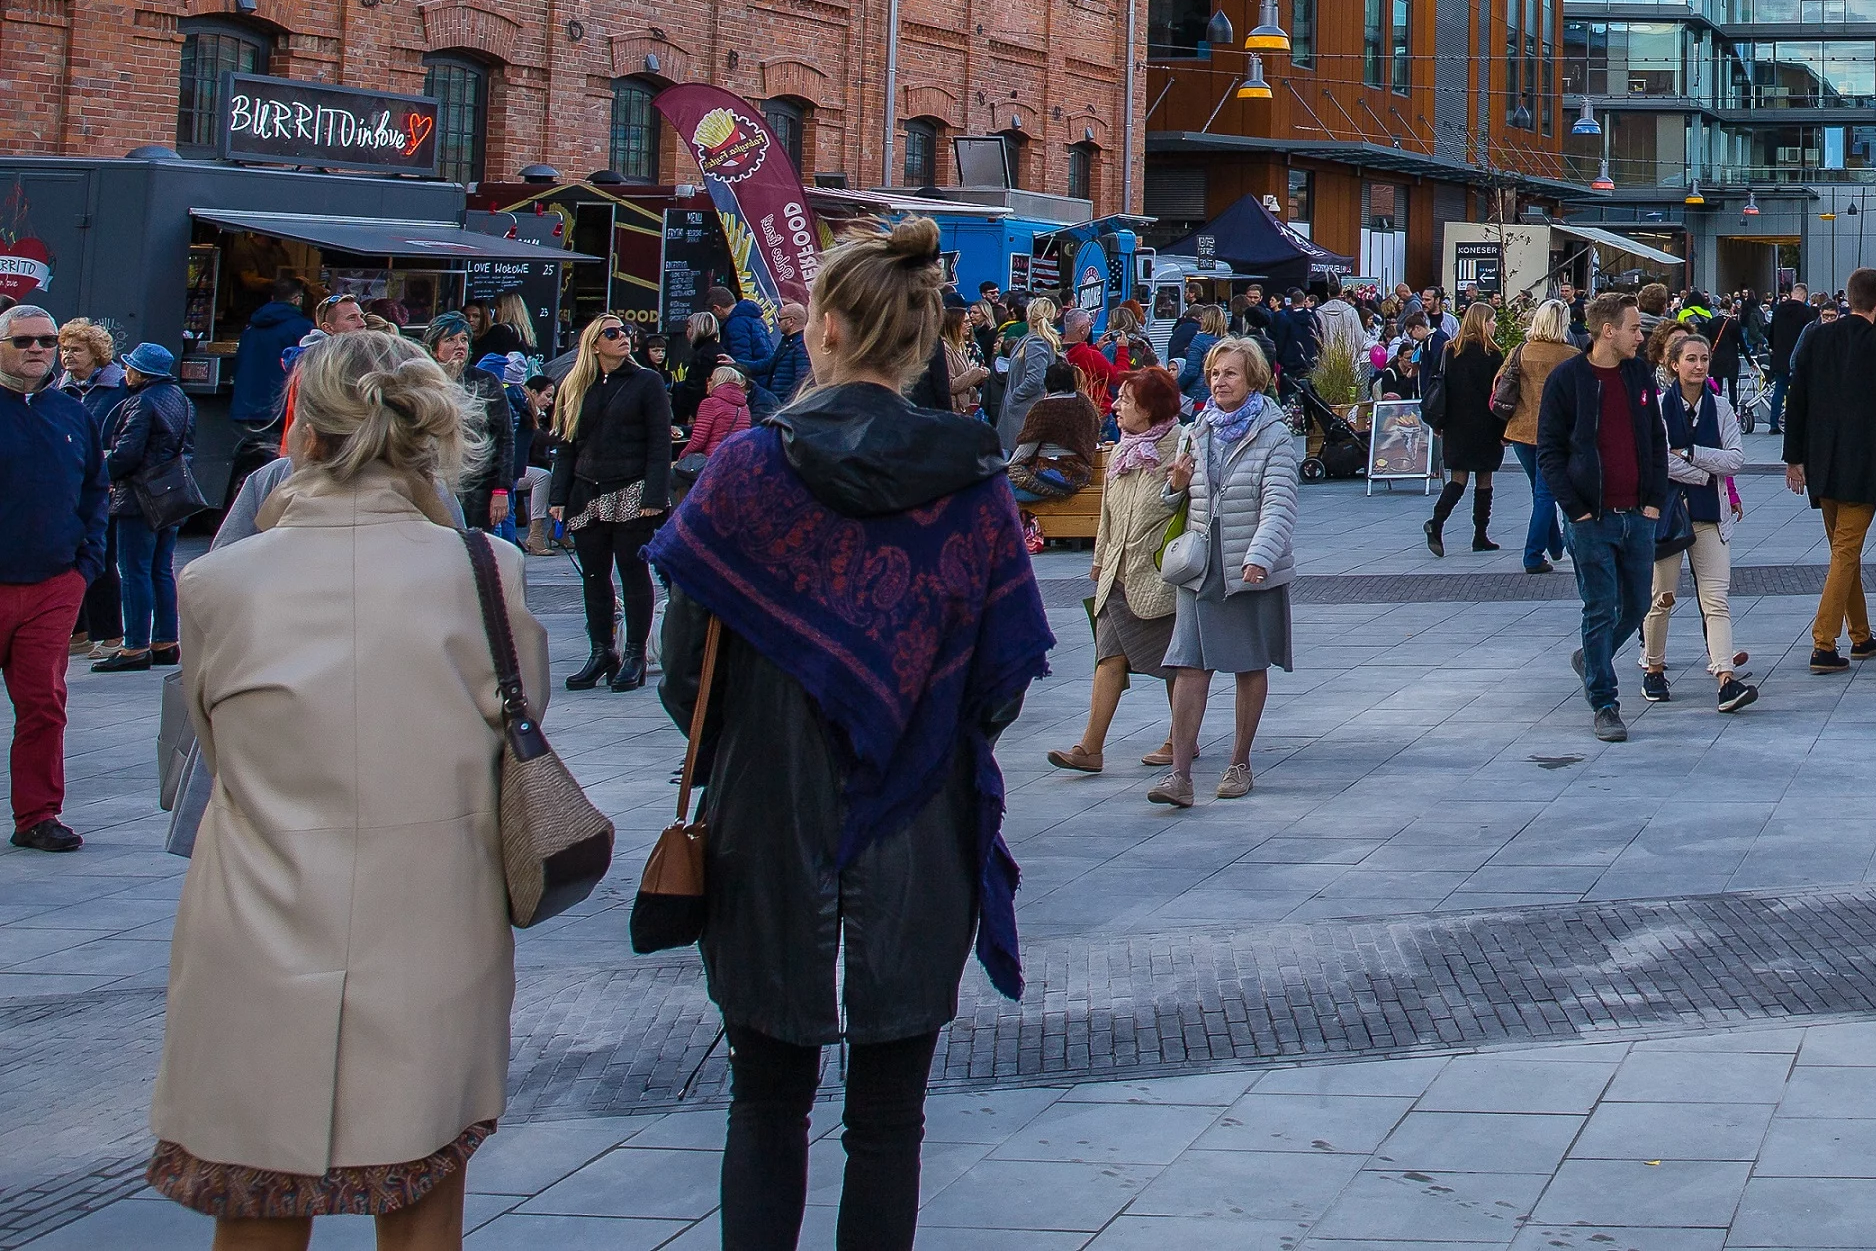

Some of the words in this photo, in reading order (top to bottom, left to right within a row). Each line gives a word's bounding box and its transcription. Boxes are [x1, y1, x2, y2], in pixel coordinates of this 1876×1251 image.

[230, 95, 356, 147] BURRITO
[1457, 246, 1498, 254] KONESER
[467, 261, 491, 273] LOVE
[542, 264, 555, 276] 25
[539, 307, 549, 318] 23
